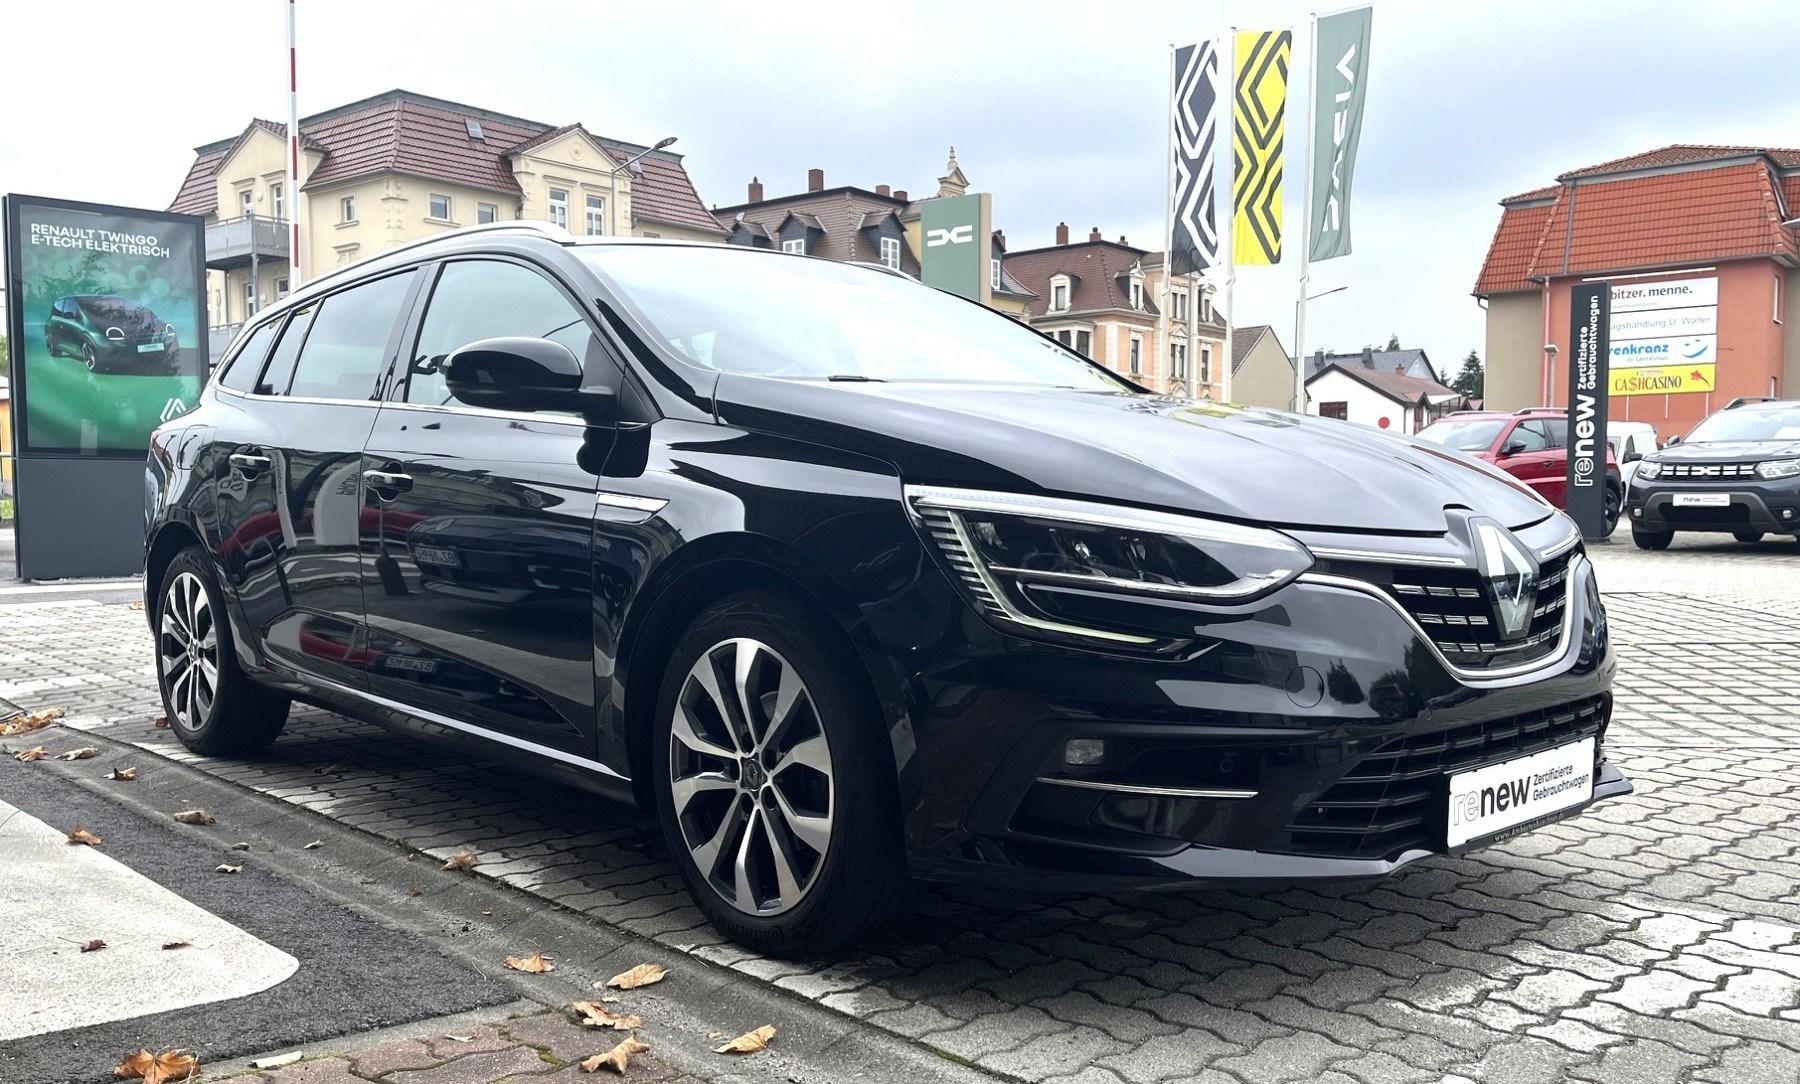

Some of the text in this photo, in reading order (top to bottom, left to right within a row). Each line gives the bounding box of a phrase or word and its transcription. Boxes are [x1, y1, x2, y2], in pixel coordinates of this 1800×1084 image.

[1322, 43, 1356, 232] DACIA
[31, 223, 158, 246] RENAULT TWINGO
[31, 234, 170, 258] E-TECH ELEKTRISCH
[1648, 285, 1693, 297] menne.
[1577, 326, 1588, 390] Zertifizierte
[1586, 295, 1600, 390] Gebrauchtwagen
[1574, 393, 1596, 487] renew
[1453, 775, 1532, 827] renew
[1533, 763, 1574, 787] Zertifizierte
[1532, 772, 1590, 802] Gebrauchtwagen
